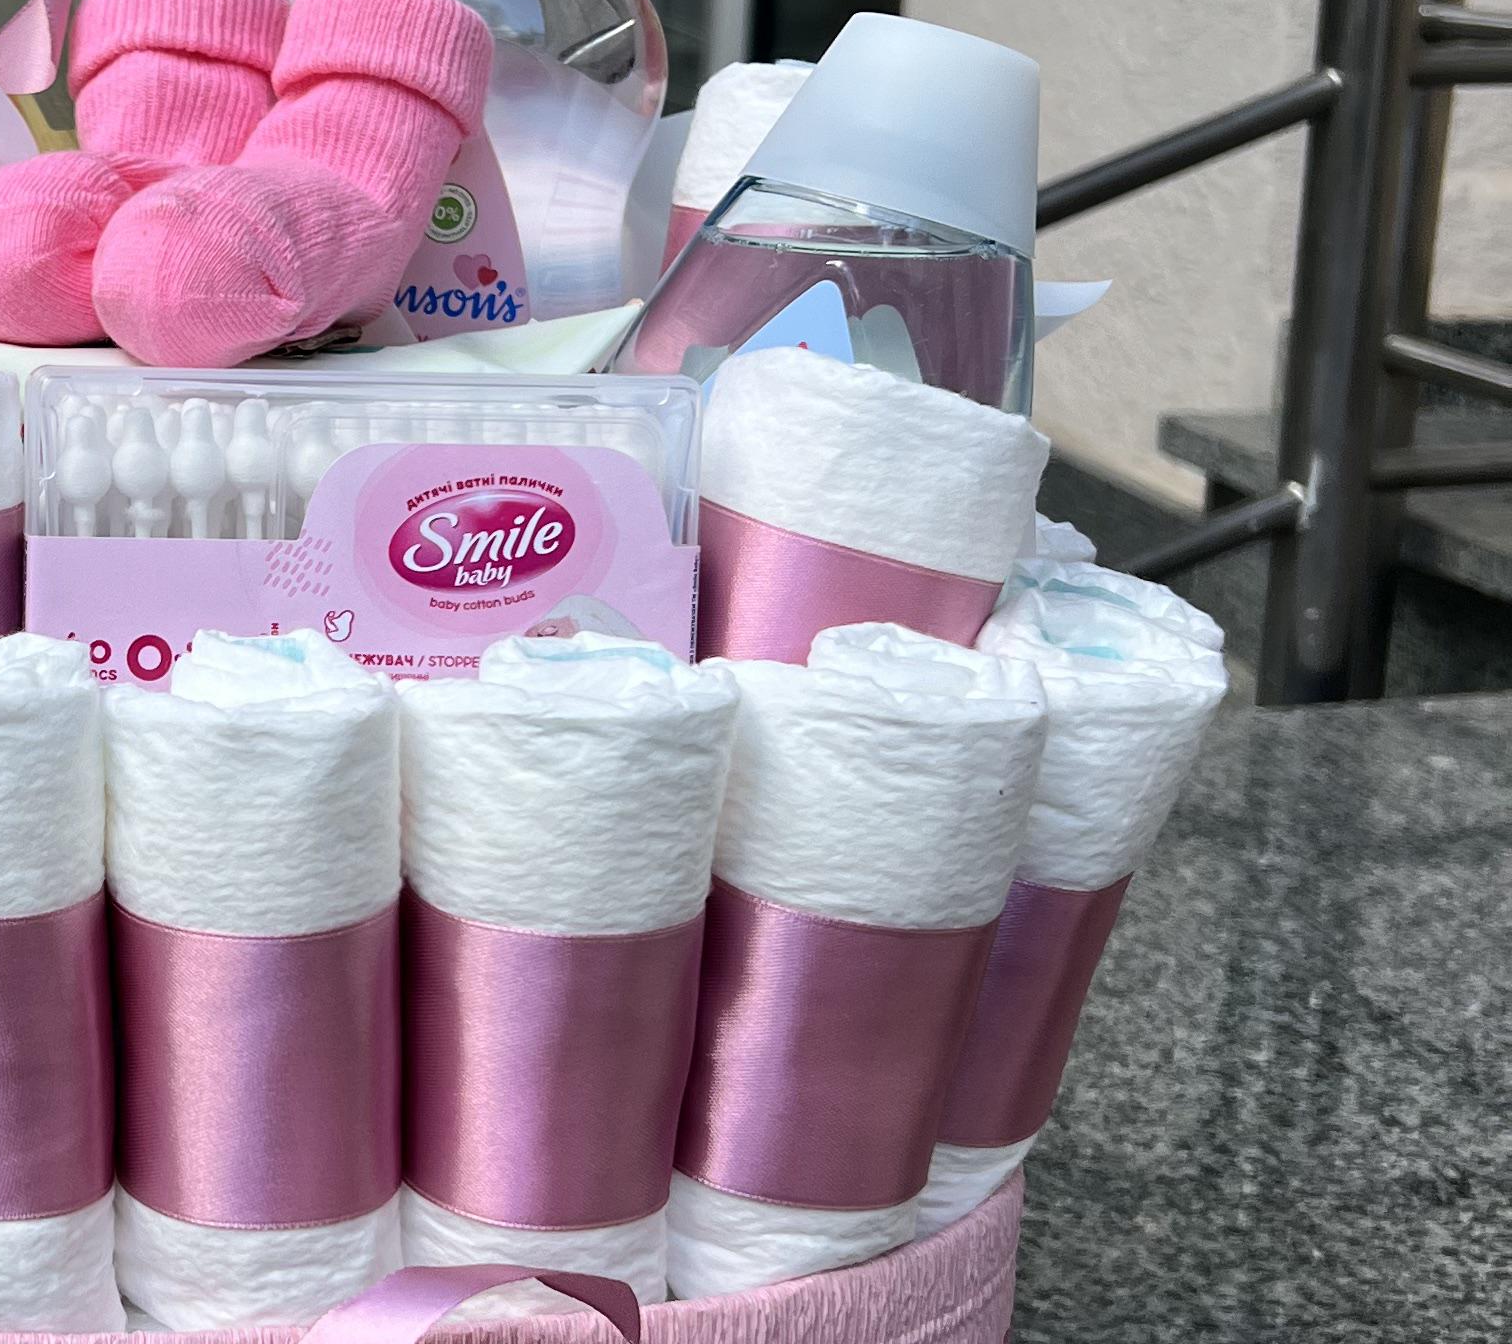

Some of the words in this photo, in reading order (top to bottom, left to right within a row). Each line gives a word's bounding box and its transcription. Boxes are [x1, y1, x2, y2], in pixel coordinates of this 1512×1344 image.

[402, 506, 564, 573] Smile
[454, 562, 513, 588] baby
[429, 597, 460, 612] baby
[463, 597, 502, 610] cotton
[504, 589, 536, 606] buds
[349, 653, 414, 667] ЕЖУВАЧ
[428, 655, 480, 668] STOPPE
